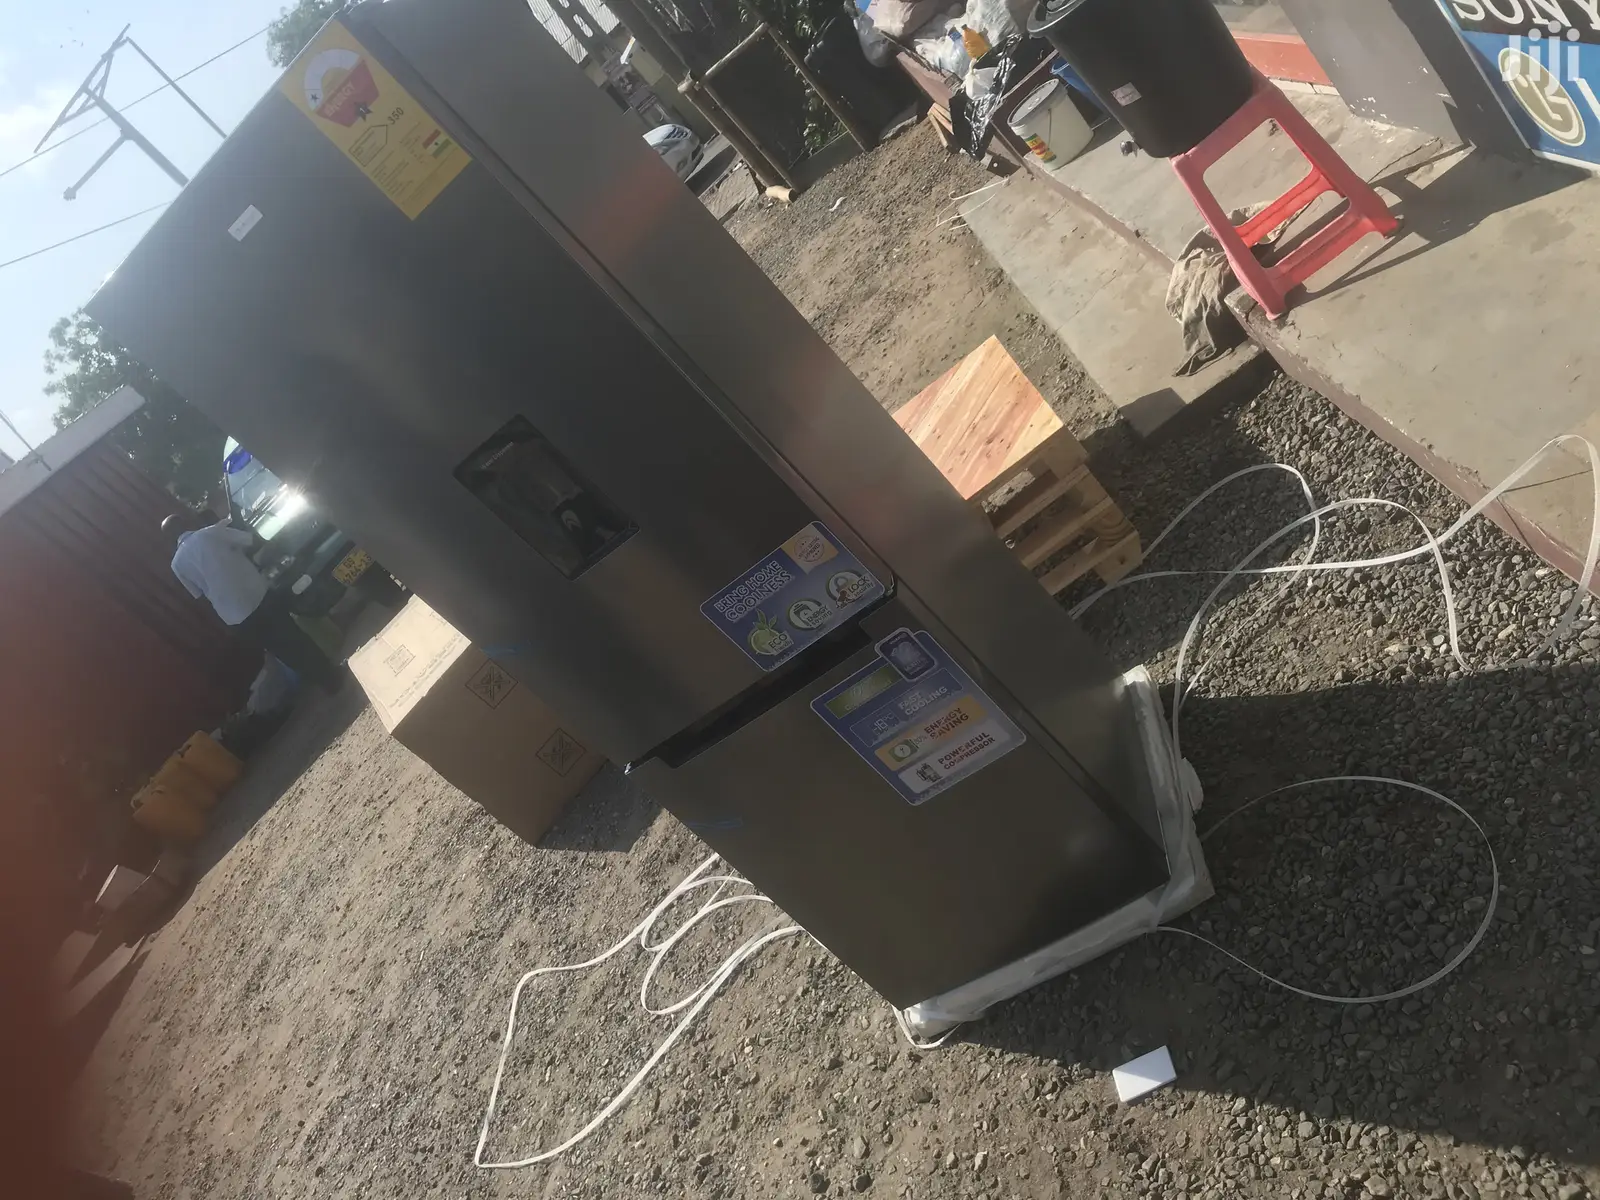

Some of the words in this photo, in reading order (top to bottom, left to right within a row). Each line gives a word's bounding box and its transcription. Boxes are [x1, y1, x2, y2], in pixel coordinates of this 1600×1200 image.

[385, 105, 405, 125] 350
[713, 583, 748, 613] BRING
[745, 559, 782, 590] HOME
[724, 569, 792, 621] COOLNESS
[847, 574, 870, 593] LOCK
[853, 580, 874, 597] security
[806, 604, 828, 622] ENERGY
[767, 631, 788, 649] ECO
[897, 691, 922, 709] FAST
[903, 685, 948, 716] COOLING
[923, 706, 961, 734] ENERGY
[929, 712, 969, 740] SAVING
[937, 729, 990, 764] POWERFUL
[943, 735, 995, 770] COMPRESSOR
